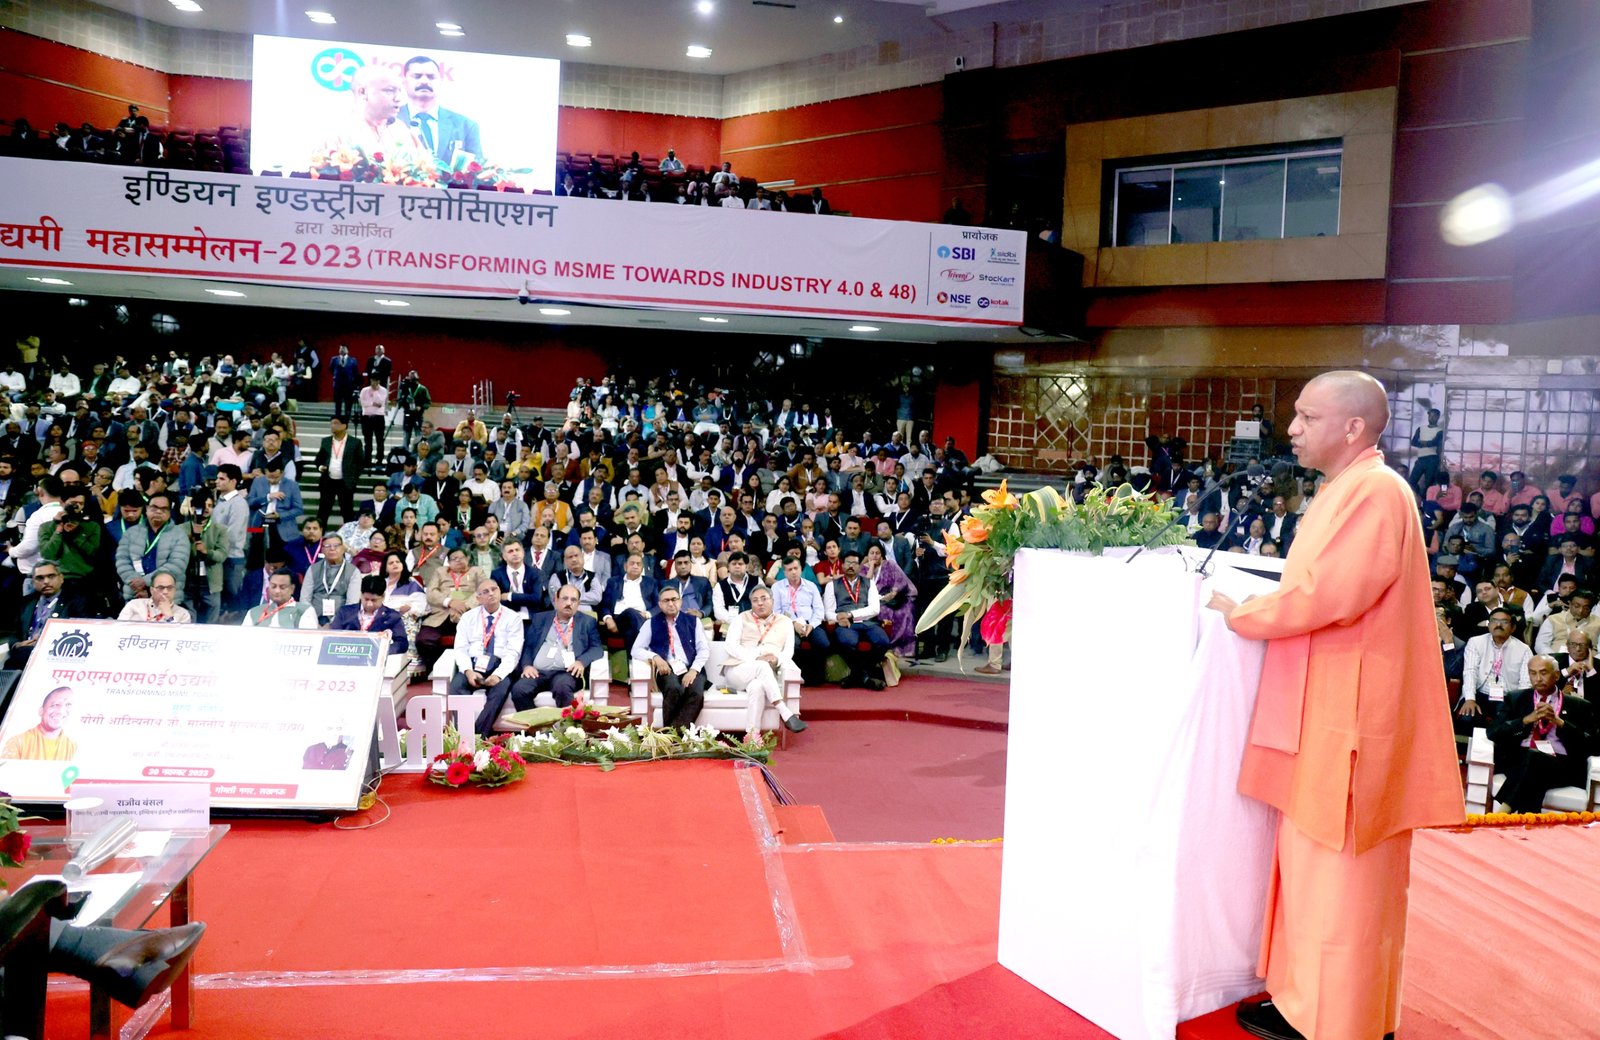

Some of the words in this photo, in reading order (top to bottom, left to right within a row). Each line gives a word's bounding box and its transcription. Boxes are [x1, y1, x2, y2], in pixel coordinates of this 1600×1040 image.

[123, 171, 240, 207] इण्डियन
[255, 184, 384, 220] इण्डस्ट्रीज
[398, 190, 558, 227] एसोसिएशन
[295, 221, 324, 235] द्वारा
[331, 222, 394, 239] आयोजित
[962, 230, 998, 241] प्रायोजक
[0, 215, 63, 252] द्यमी
[367, 248, 547, 277] (TRANSFORMING
[554, 261, 615, 281] MSME
[622, 265, 725, 288] TOWARDS
[731, 272, 832, 296] INDUSTRY
[837, 280, 864, 297] 4.0
[870, 282, 883, 298] &
[888, 282, 917, 304] 48)
[952, 247, 975, 261] SBI
[950, 293, 971, 304] NSE
[117, 634, 170, 651] इण्डियन
[334, 645, 358, 653] HDMI
[360, 645, 364, 653] 1
